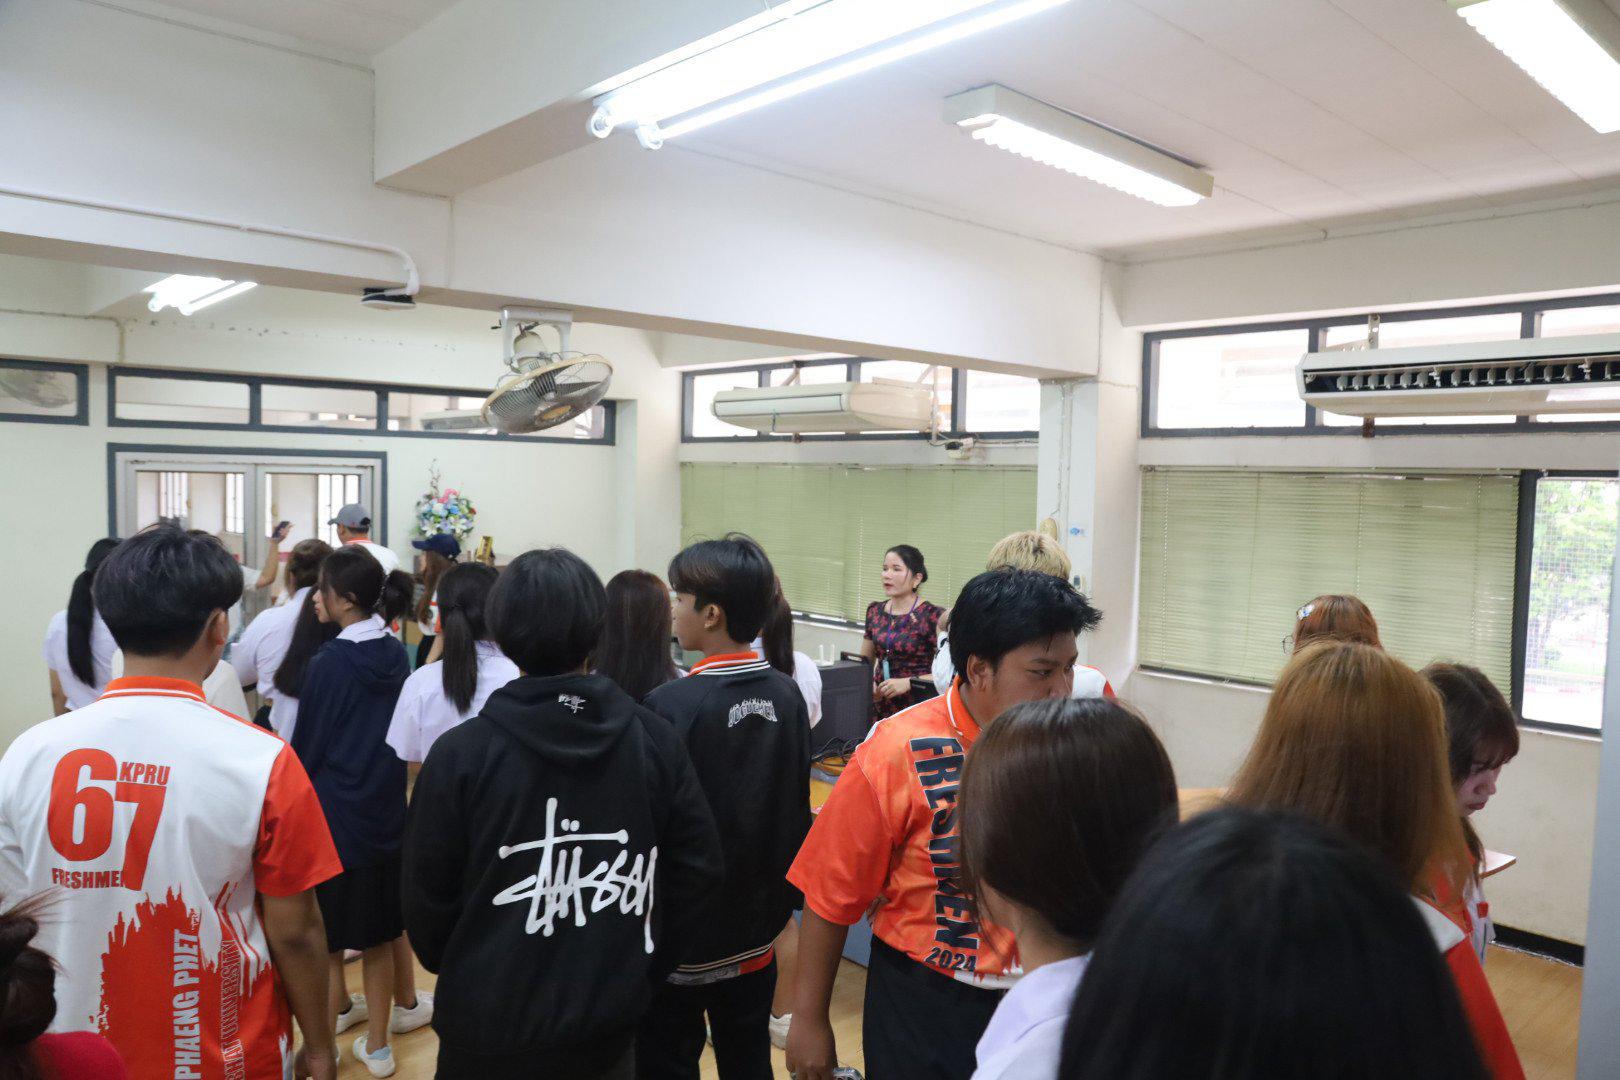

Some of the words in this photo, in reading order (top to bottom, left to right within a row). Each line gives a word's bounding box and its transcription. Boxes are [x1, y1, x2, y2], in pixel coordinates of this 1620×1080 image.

[119, 762, 171, 785] KPRU
[48, 748, 167, 891] 67
[173, 928, 200, 987] PHET
[221, 940, 241, 1039] UNIVERSITY
[924, 947, 977, 972] 2024
[172, 990, 201, 1080] PHAENG
